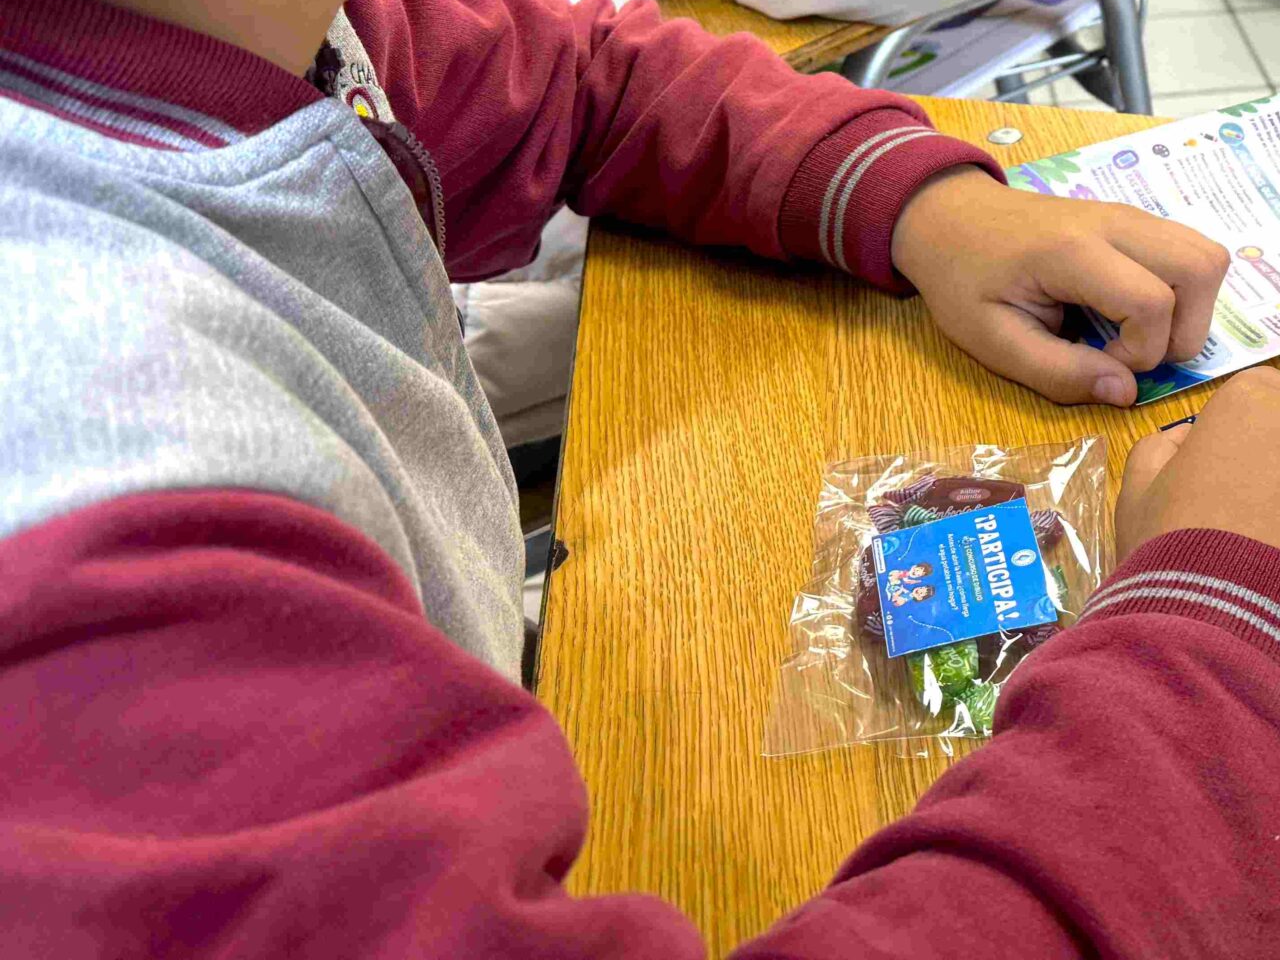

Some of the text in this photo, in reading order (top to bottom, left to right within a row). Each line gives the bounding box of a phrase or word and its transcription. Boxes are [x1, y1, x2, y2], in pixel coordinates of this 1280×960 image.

[966, 548, 982, 601] CONCURSO DE DIBUJO
[975, 514, 1019, 621] ¡PARTICIPA!
